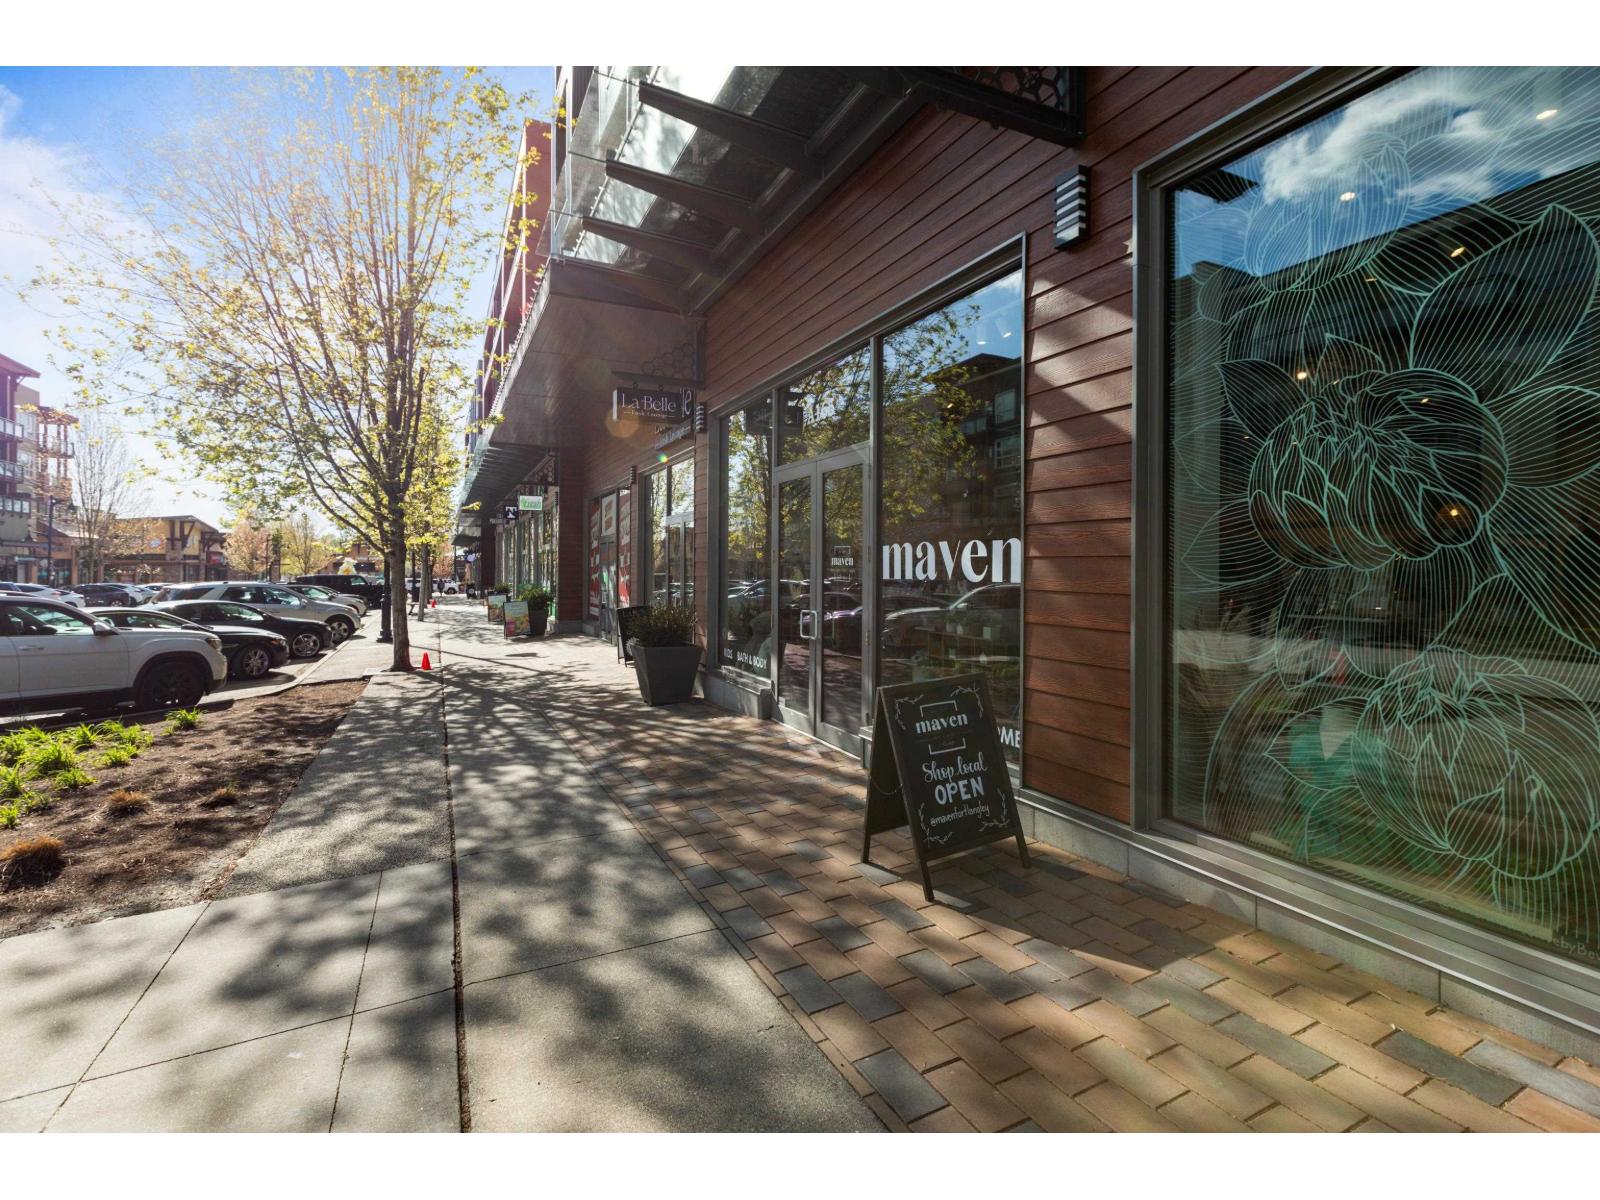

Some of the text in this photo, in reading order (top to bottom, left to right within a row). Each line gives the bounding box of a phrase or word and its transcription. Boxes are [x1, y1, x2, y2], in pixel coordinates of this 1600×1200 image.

[622, 393, 640, 409] La
[642, 395, 677, 412] Belle
[831, 557, 854, 566] maven
[882, 537, 1022, 584] maven
[753, 655, 767, 669] BODY
[915, 713, 968, 735] maven
[922, 751, 987, 783] Shop local
[934, 776, 985, 806] OPEN
